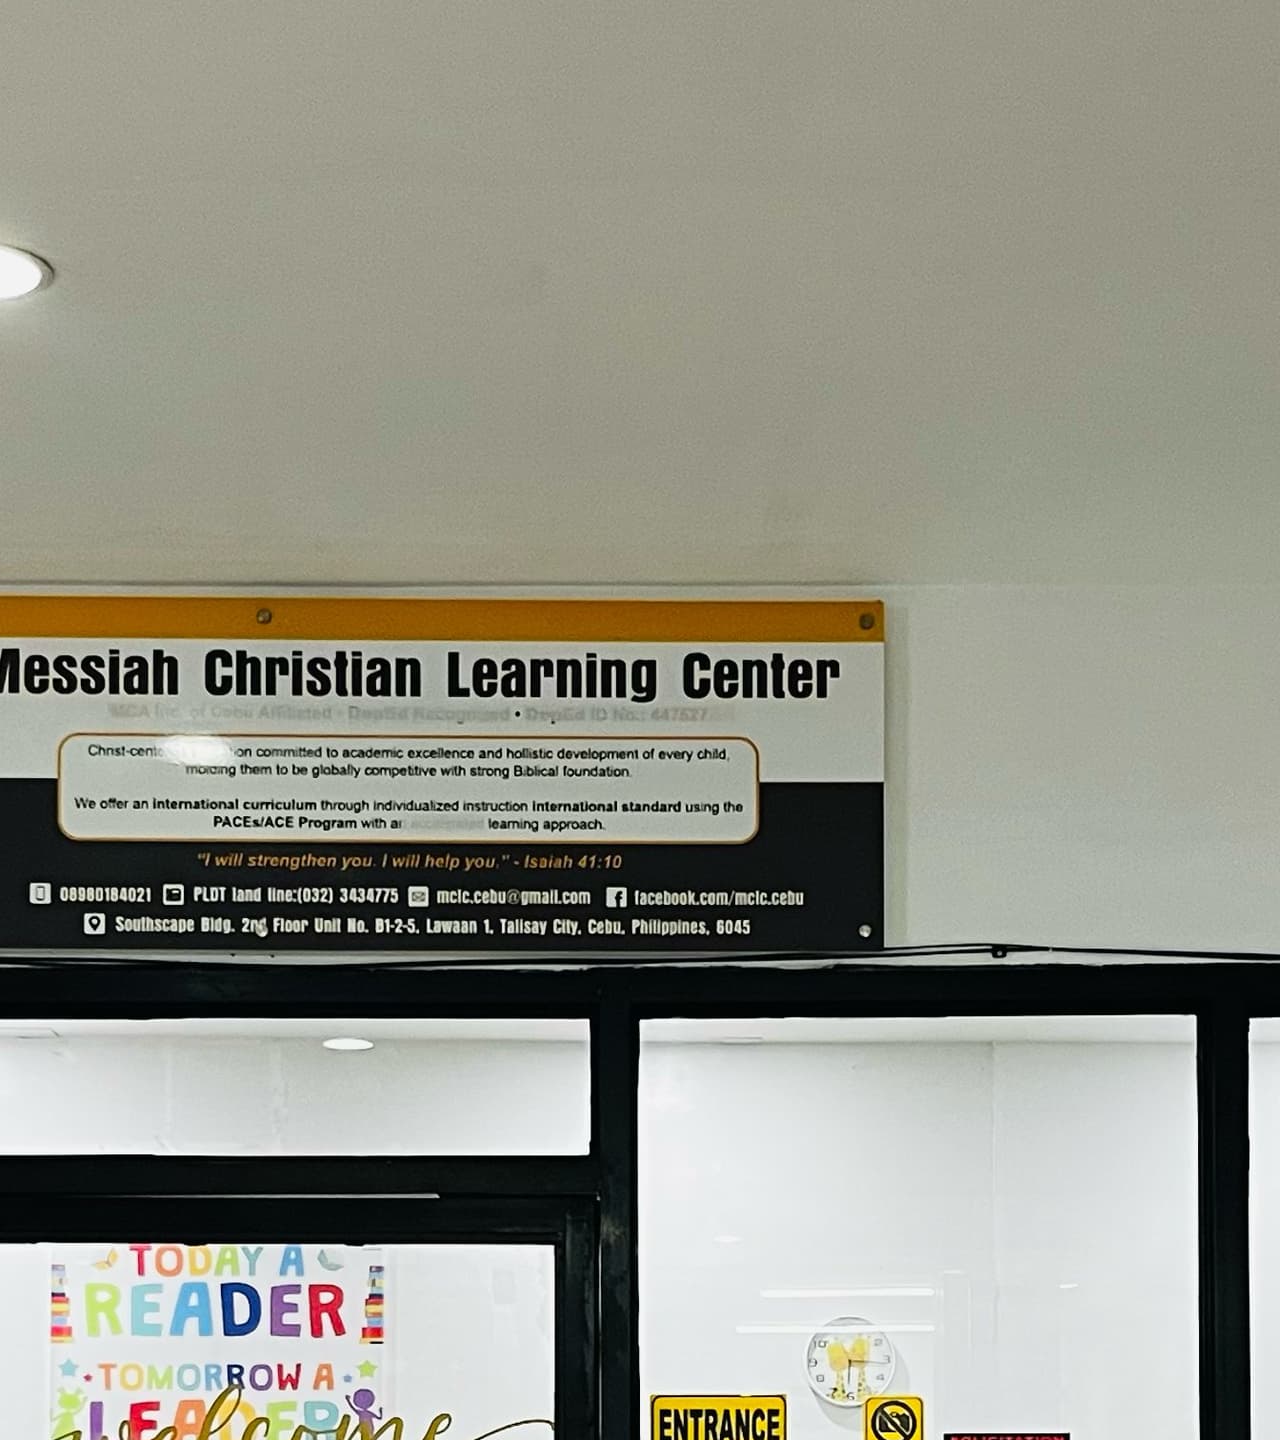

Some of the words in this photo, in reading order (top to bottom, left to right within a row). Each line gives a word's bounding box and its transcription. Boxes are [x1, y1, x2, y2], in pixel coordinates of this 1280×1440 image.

[205, 649, 421, 697] Christian
[448, 652, 657, 703] Learning
[683, 652, 840, 700] Center
[256, 747, 322, 759] committed
[326, 747, 339, 759] to
[342, 747, 404, 760] academic
[408, 749, 474, 760] excellence
[478, 748, 503, 760] and
[557, 748, 639, 763] development
[642, 748, 656, 760] of
[658, 751, 693, 764] every
[241, 764, 272, 776] them
[276, 765, 288, 776] to
[292, 765, 308, 776] be
[311, 765, 361, 779] globally
[364, 766, 436, 780] competitive
[440, 767, 466, 777] with
[470, 768, 510, 780] strong
[514, 767, 559, 778] Biblical
[74, 798, 97, 810] We
[99, 798, 129, 810] offer
[133, 800, 149, 810] an
[153, 798, 239, 811] international
[243, 799, 317, 811] curriculum
[321, 800, 370, 813] through
[373, 800, 459, 812] individualized
[463, 800, 528, 812] instruction
[532, 801, 618, 813] international
[621, 801, 682, 813] standard
[685, 802, 720, 815] using
[724, 802, 743, 813] the
[214, 816, 294, 829] PACEs/ACE
[298, 817, 357, 832] Program
[361, 818, 387, 829] with
[488, 818, 538, 832] learning
[215, 854, 243, 867] will
[247, 854, 336, 871] strengthen
[391, 855, 420, 868] will
[425, 855, 459, 871] help
[524, 855, 572, 868] Isaiah
[578, 856, 622, 869] 41:10
[193, 886, 227, 902] PLDT
[232, 886, 262, 902] land
[340, 887, 399, 903] 3434775
[115, 916, 195, 934] Southscape
[201, 917, 236, 934] Bldg.
[273, 917, 309, 933] Floor
[314, 917, 341, 933] Unit
[347, 918, 369, 933] No.
[426, 919, 477, 934] Lawaan
[500, 919, 547, 936] Talisay
[716, 919, 751, 935] 6045
[129, 1246, 264, 1278] TODAY
[279, 1246, 305, 1278] A
[85, 1282, 346, 1338] READER
[98, 1363, 302, 1391] TOMORROW
[314, 1363, 335, 1391] A
